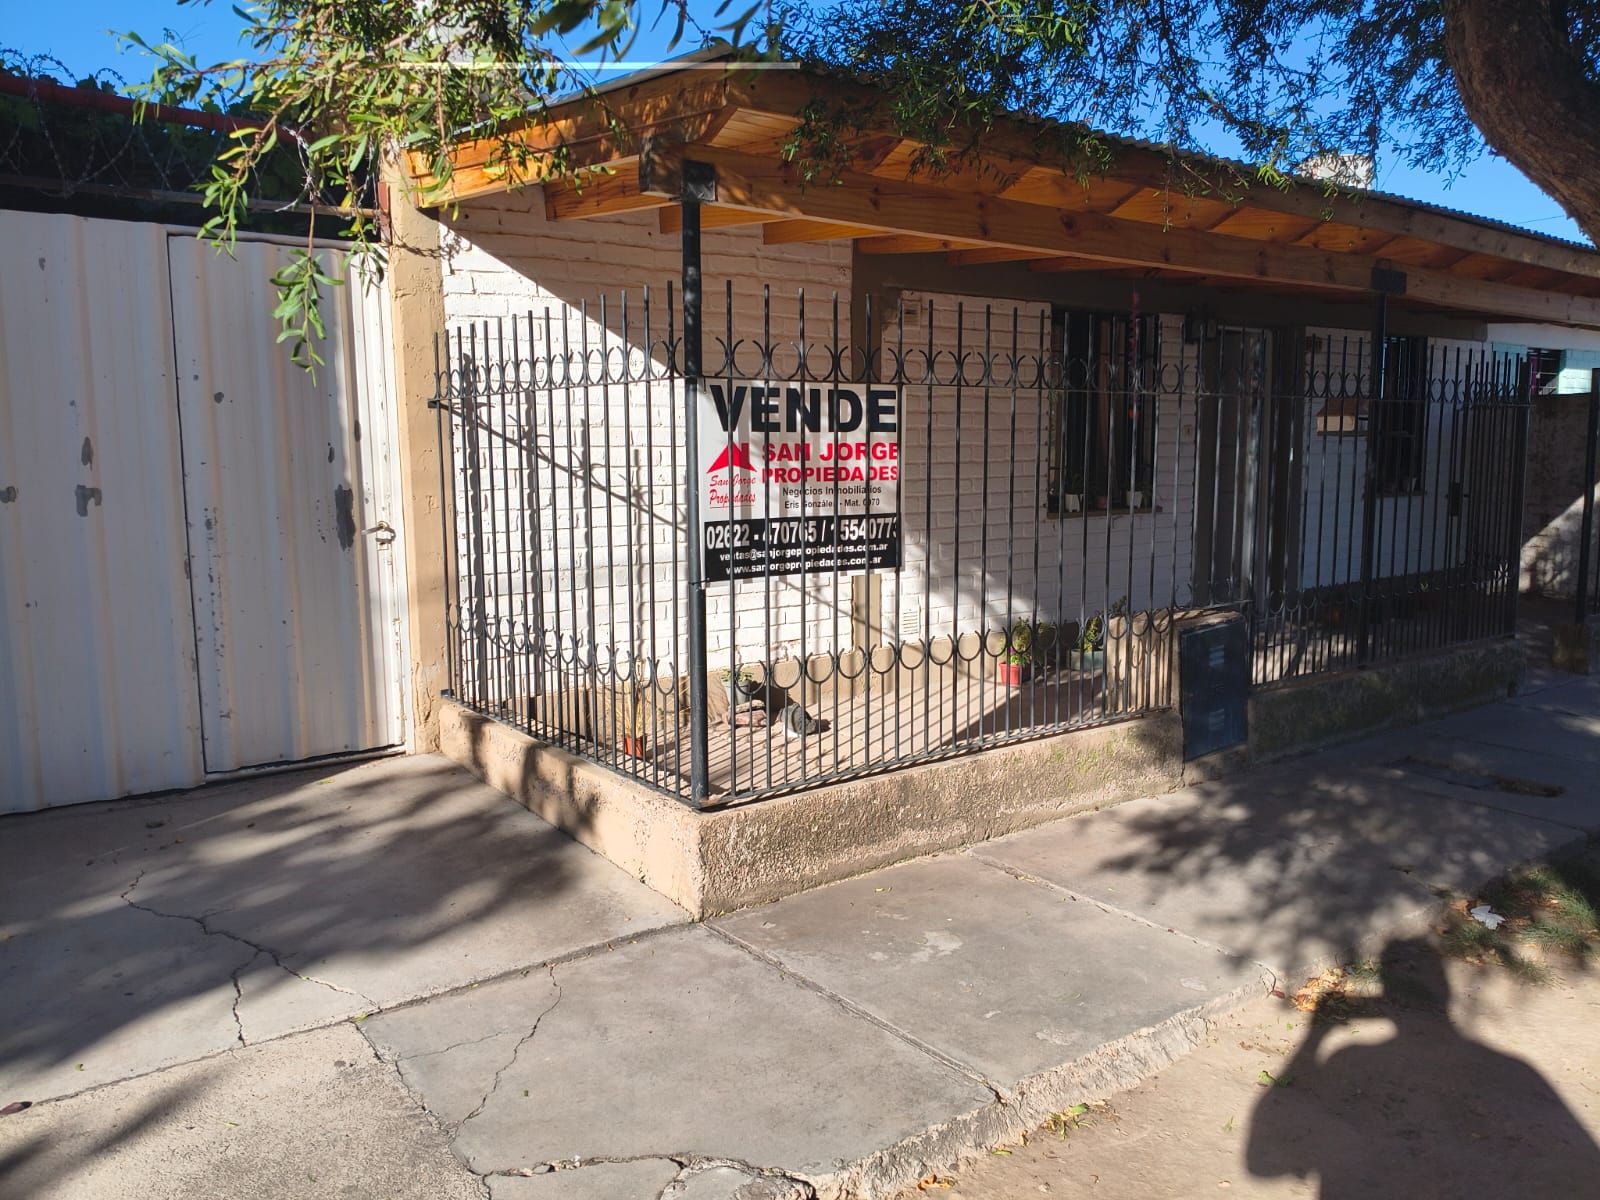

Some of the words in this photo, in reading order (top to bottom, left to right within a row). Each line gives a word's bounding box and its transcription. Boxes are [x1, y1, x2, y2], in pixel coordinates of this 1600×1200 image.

[710, 385, 896, 432] VENDE
[762, 442, 810, 462] SAN
[819, 442, 897, 461] JORGE
[762, 466, 897, 483] PROPIEDADES
[784, 500, 799, 509] Eris
[844, 499, 860, 507] Mat.
[706, 523, 750, 549] 02622
[821, 520, 827, 542] /
